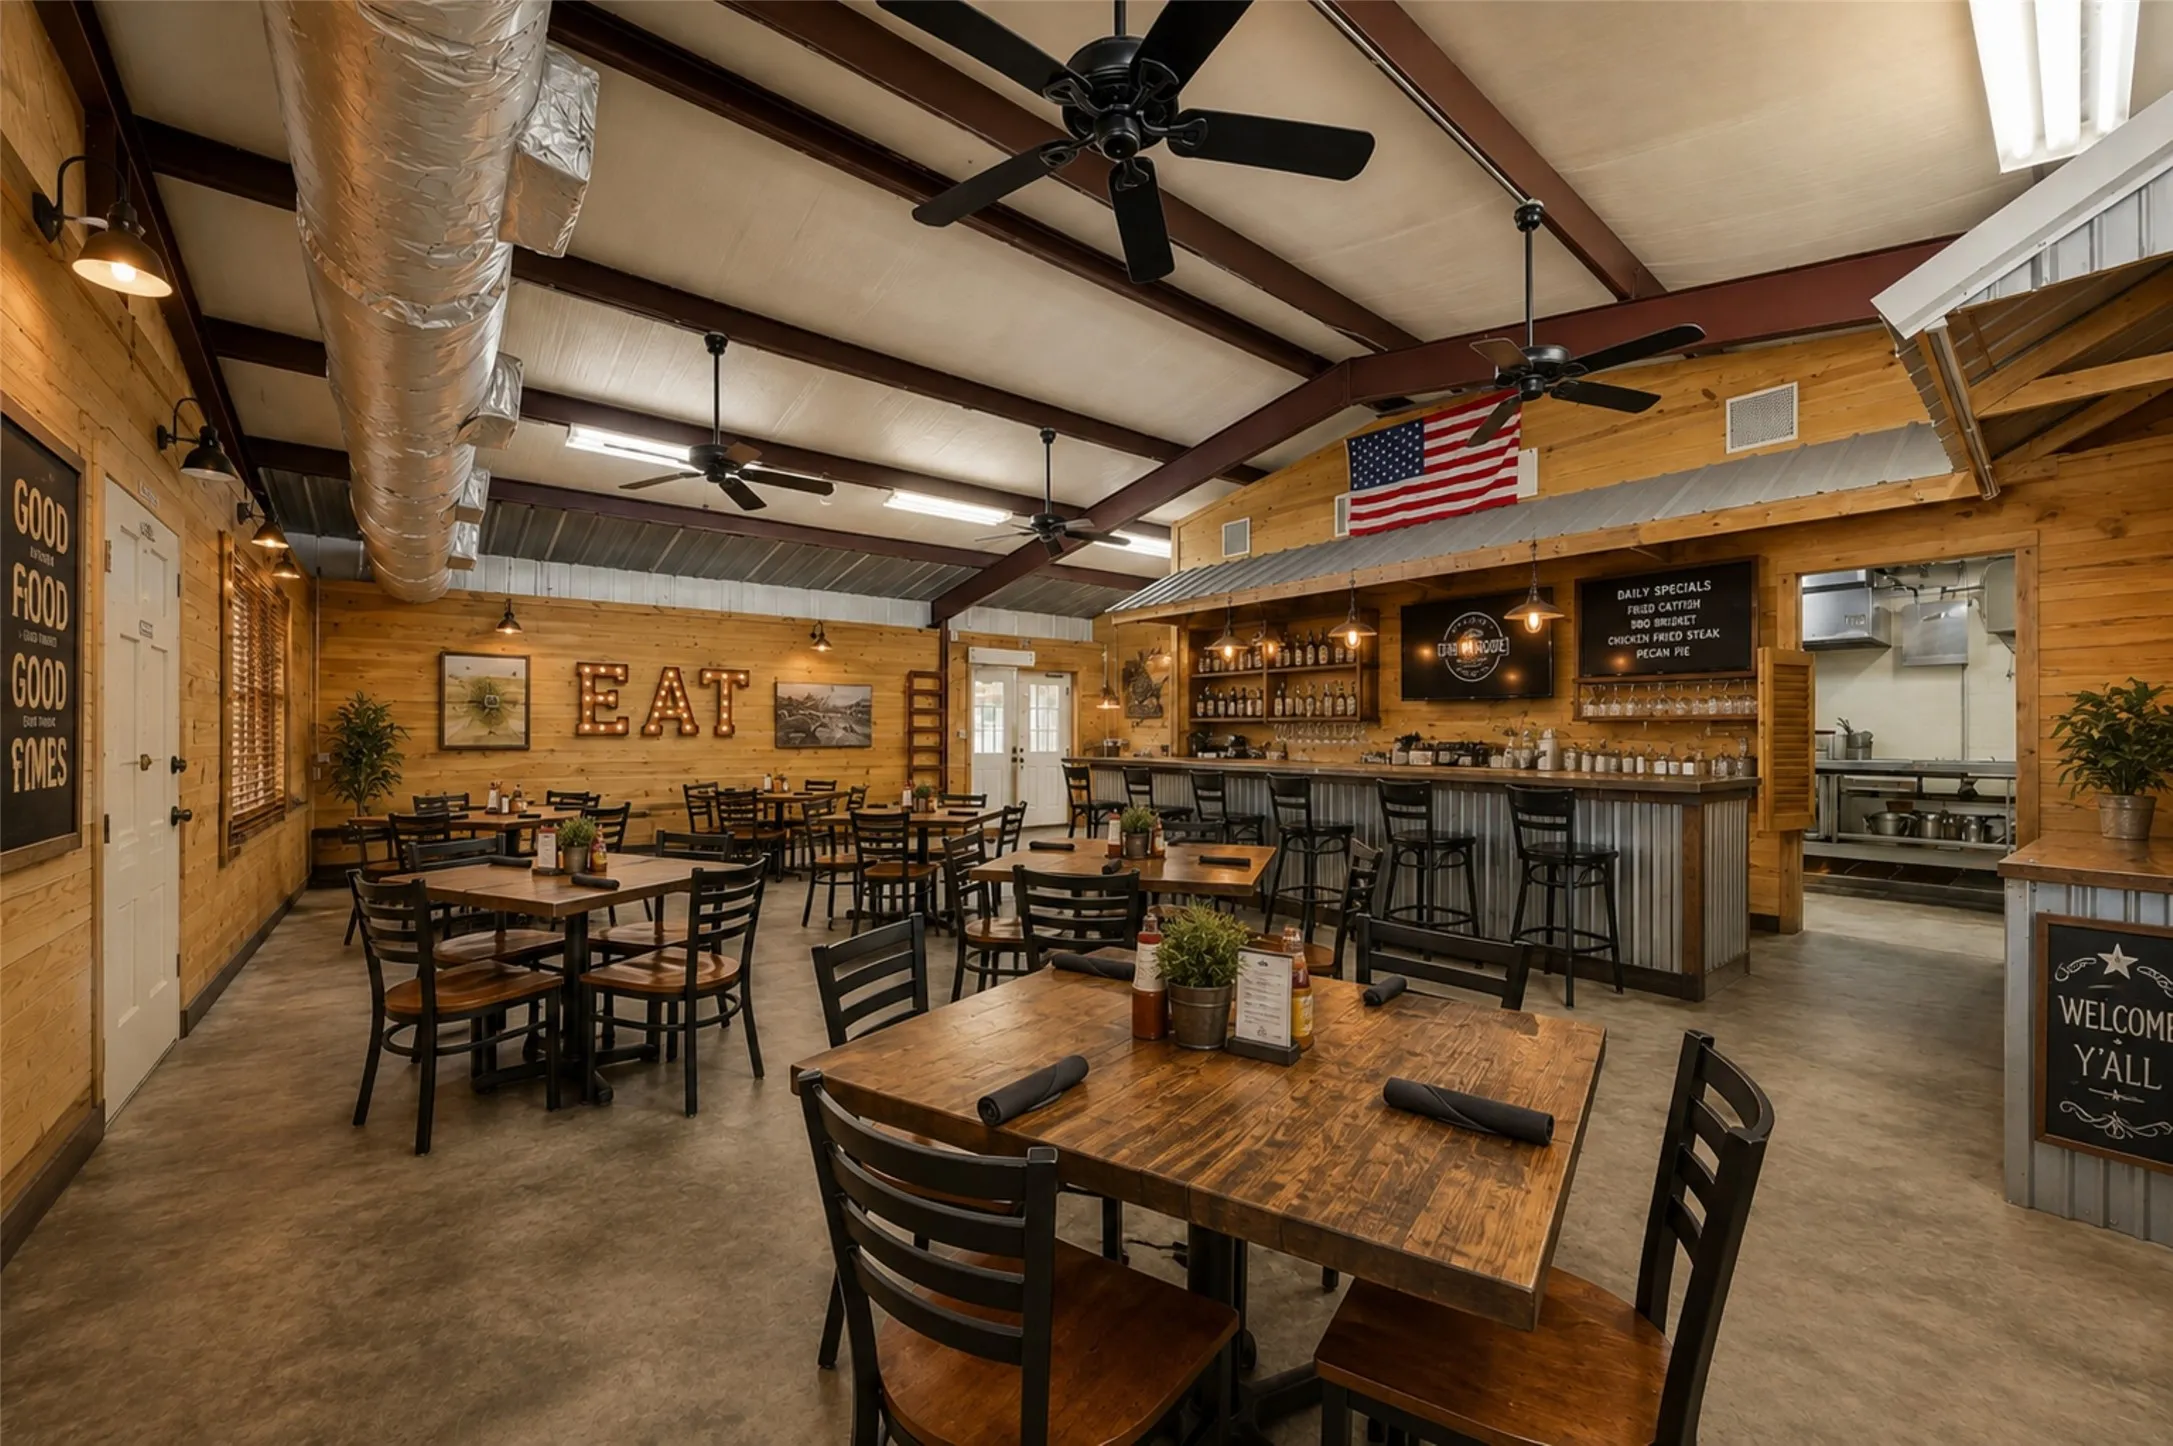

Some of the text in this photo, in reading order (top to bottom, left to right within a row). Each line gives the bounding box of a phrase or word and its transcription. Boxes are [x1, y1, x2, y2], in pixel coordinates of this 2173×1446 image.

[14, 478, 69, 554] GOOD
[1617, 580, 1712, 601] DAILY SPECIALS
[1636, 646, 1691, 659] PECAN PIE
[1687, 628, 1720, 640] STEAK
[12, 652, 67, 710] GOOD
[576, 662, 750, 737] EAT
[2074, 1043, 2162, 1090] Y'ALL
